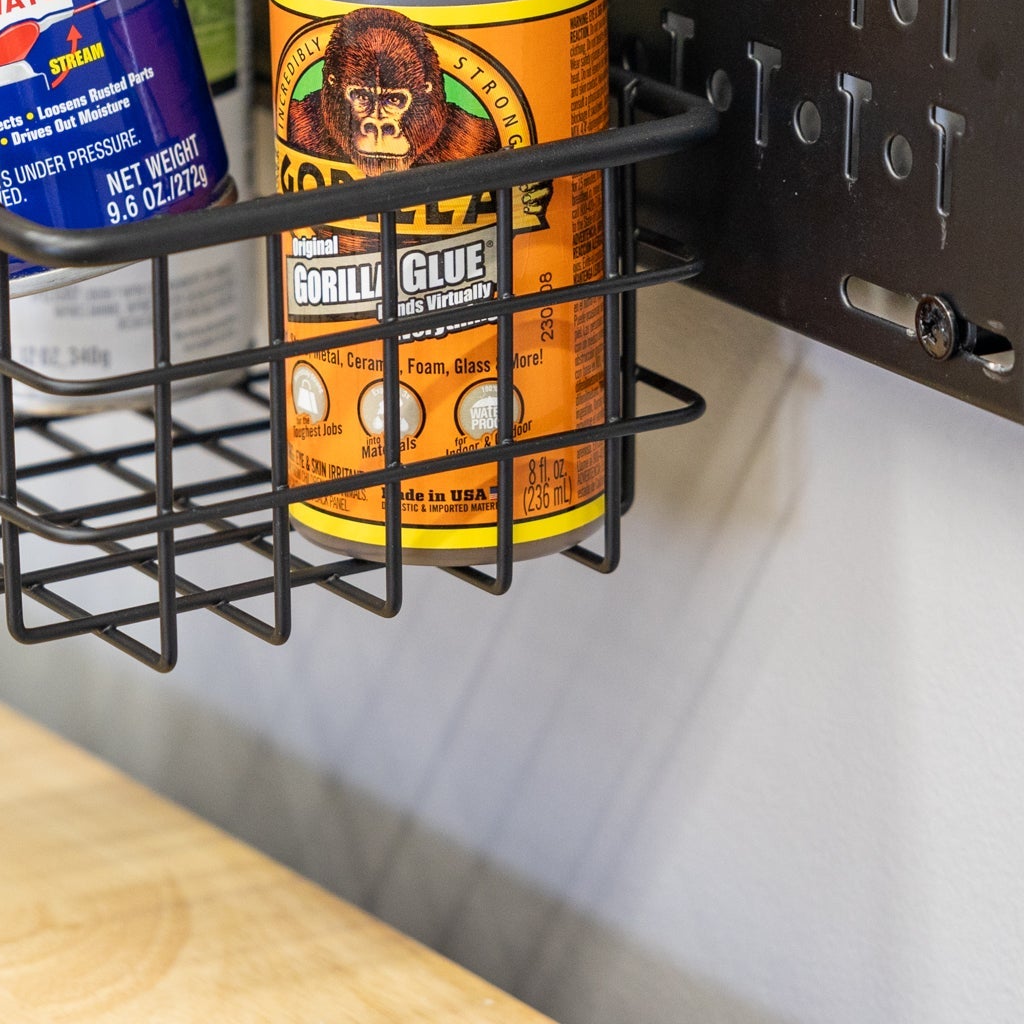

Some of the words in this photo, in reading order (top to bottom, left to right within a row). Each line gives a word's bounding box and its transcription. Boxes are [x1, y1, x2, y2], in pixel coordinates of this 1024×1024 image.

[48, 42, 106, 76] STREAM
[36, 94, 88, 120] Loosens
[88, 76, 128, 103] Rusted
[127, 66, 155, 88] Parts
[278, 36, 321, 129] INCREDIBLY
[453, 56, 523, 149] STRONG
[11, 126, 53, 146] Drives
[54, 116, 78, 134] Out
[78, 97, 131, 126] Moisture
[14, 154, 67, 185] UNDER
[68, 127, 142, 169] PRESSURE.
[106, 162, 143, 196] NET
[144, 133, 199, 180] WEIGHT
[107, 194, 139, 225] 9.6
[292, 235, 339, 259] Original
[402, 242, 484, 293] GLUE
[377, 298, 424, 320] nds
[426, 281, 492, 307] Virtually
[539, 271, 554, 342] 23008
[408, 358, 450, 377] Foam,
[454, 358, 491, 374] Glass
[470, 405, 498, 419] WATE
[471, 418, 498, 431] PRO
[323, 422, 343, 437] Jobs
[366, 436, 381, 447] into
[455, 436, 468, 447] for
[484, 435, 491, 448] &
[362, 438, 417, 460] Matals
[312, 458, 327, 478] SKIN
[528, 458, 537, 486] 8
[538, 456, 551, 484] fl.
[553, 458, 568, 479] oz.
[381, 487, 425, 502] de
[428, 489, 446, 502] in
[450, 488, 488, 502] USA
[382, 501, 419, 512] DSTIC
[421, 502, 427, 513] &
[429, 502, 469, 513] IMPORTED
[471, 501, 498, 512] MATER
[522, 481, 551, 516] (236
[554, 476, 574, 508] mL)
